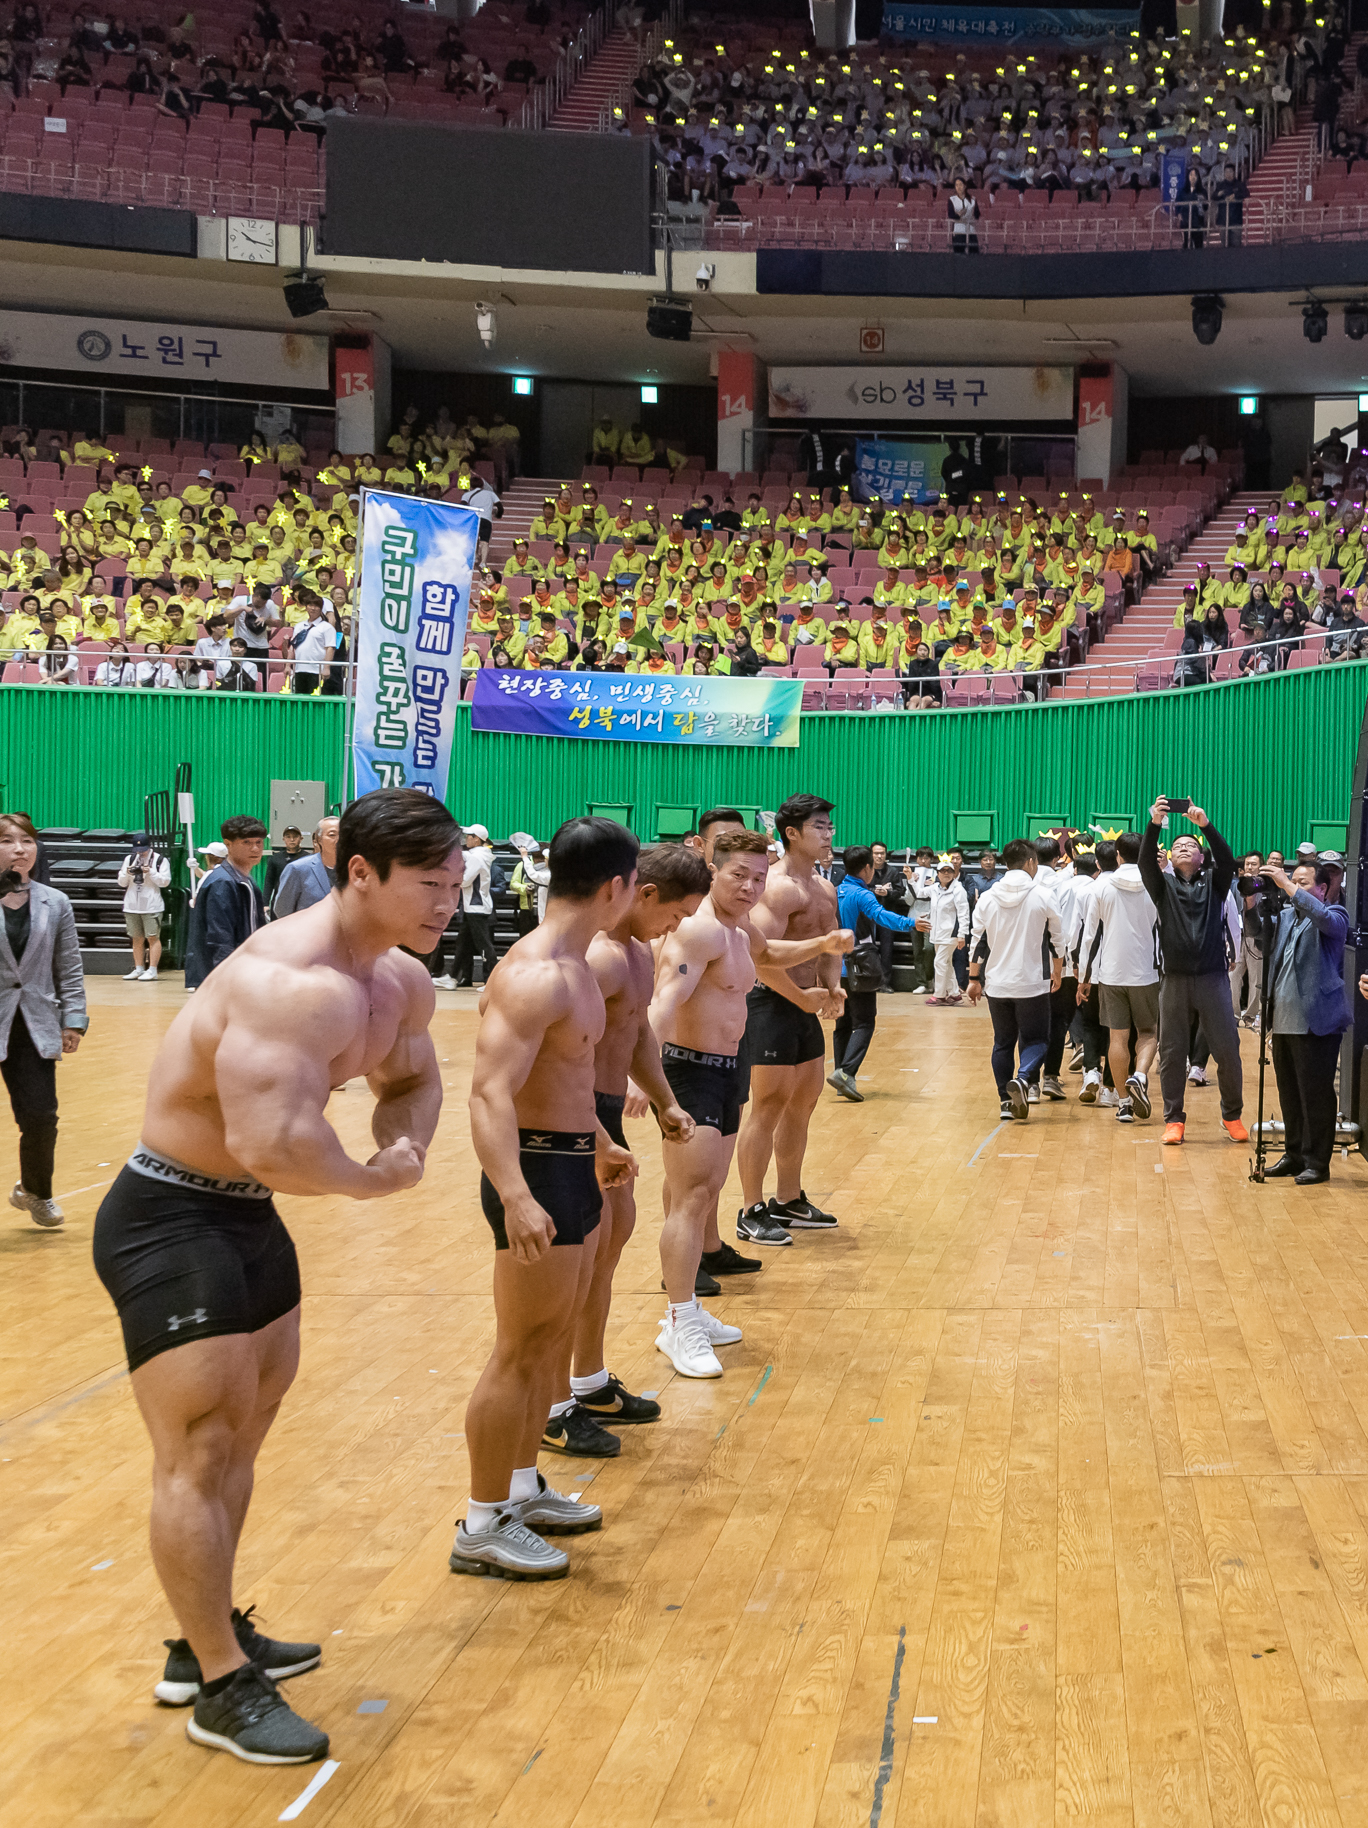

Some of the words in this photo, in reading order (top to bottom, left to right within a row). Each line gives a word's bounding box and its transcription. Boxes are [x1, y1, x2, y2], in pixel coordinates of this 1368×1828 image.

[247, 220, 257, 229] 12
[230, 234, 237, 242] 9
[268, 239, 275, 247] 3
[249, 252, 256, 261] 6
[119, 333, 222, 368] 노원구
[341, 371, 370, 395] 13
[902, 378, 989, 407] 성북구
[721, 394, 748, 416] 14
[1082, 401, 1110, 423] 14
[382, 526, 417, 632] 구민이
[417, 582, 458, 654] 함께
[498, 674, 599, 701] 현장중심,
[609, 682, 709, 706] 민생중심,
[568, 705, 664, 733] 성북에서
[673, 711, 720, 736] 답을
[727, 714, 782, 737] 찾다.
[132, 1152, 250, 1194] ARMOUR
